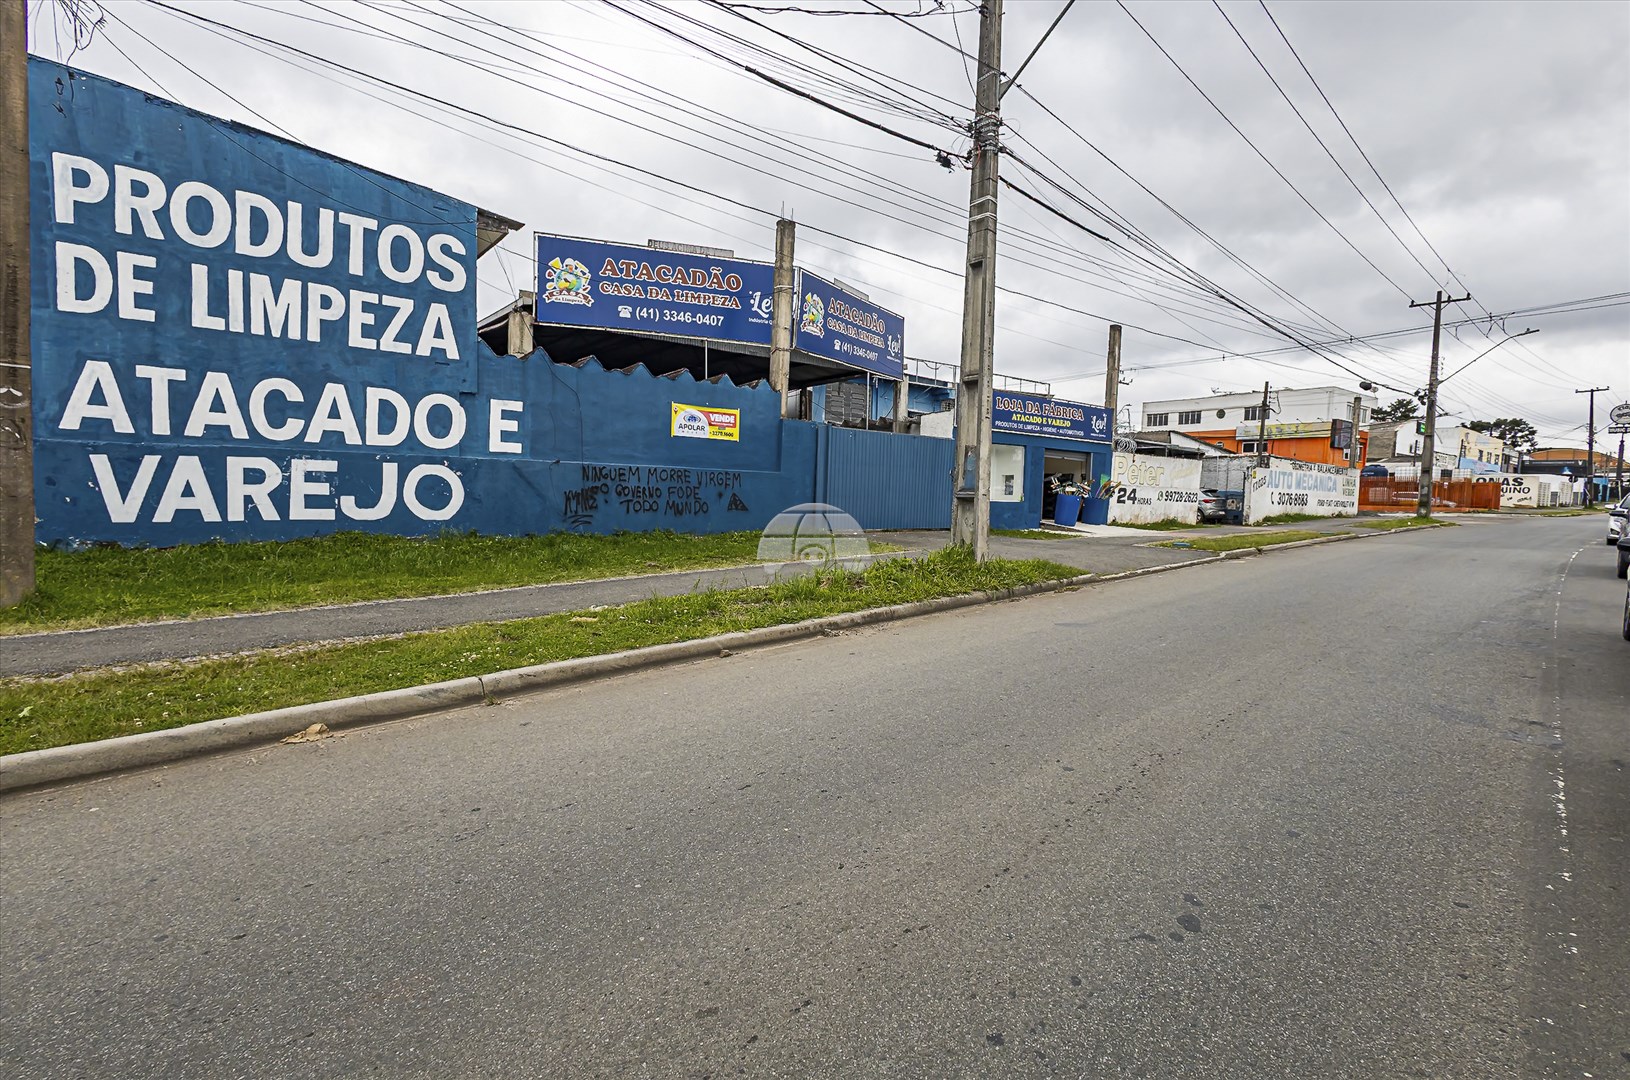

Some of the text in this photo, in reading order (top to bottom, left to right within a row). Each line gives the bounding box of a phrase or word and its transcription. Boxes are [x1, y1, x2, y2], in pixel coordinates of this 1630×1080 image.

[52, 151, 466, 292] PRODUTOS
[599, 258, 742, 291] ATACADÃO
[55, 241, 460, 360] DE LIMPEZA
[599, 282, 741, 309] CASA DA LIMPEZA
[636, 307, 724, 326] (41) 3346-0407
[828, 297, 885, 334] ATACADÃO
[827, 317, 847, 334] CASA
[848, 323, 858, 337] DA
[859, 328, 885, 348] LIMPEZA
[841, 341, 852, 356] (41)
[58, 360, 523, 453] ATACADO E
[709, 414, 735, 423] VENDE
[996, 396, 1084, 421] LOJA DA FÁBRICA
[1012, 413, 1041, 425] ATACADO
[1048, 419, 1071, 427] VAREJO
[1024, 423, 1040, 431] LIMPEZA
[582, 465, 742, 489] NINGUEM MORRE VIRGEM
[1113, 455, 1165, 486] Peter
[1267, 470, 1292, 490] AUTO
[89, 453, 465, 523] VAREJO
[615, 483, 662, 499] GOVERNO
[668, 486, 702, 500] FODE
[1117, 488, 1137, 504] 24
[620, 499, 709, 516] TODO MUNDO
